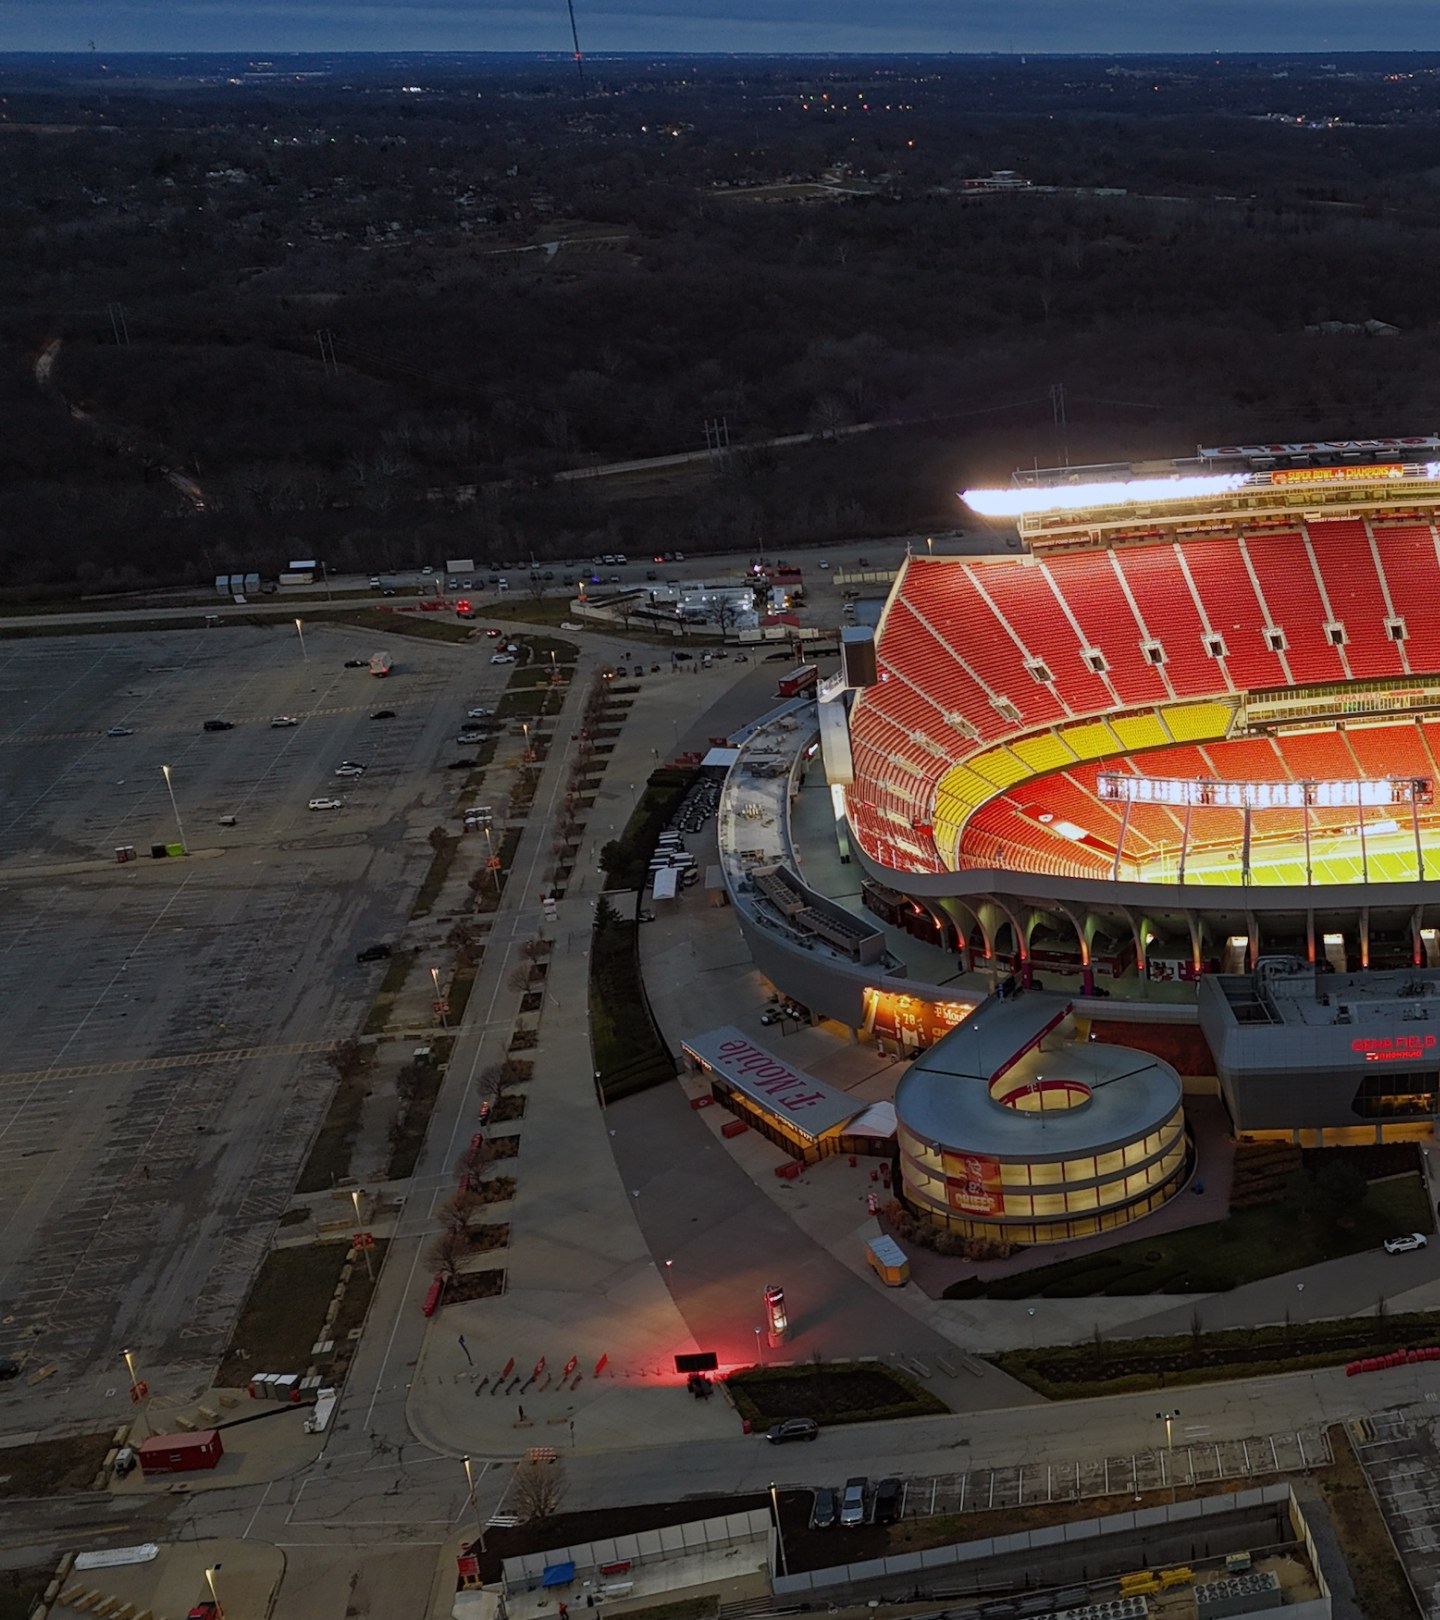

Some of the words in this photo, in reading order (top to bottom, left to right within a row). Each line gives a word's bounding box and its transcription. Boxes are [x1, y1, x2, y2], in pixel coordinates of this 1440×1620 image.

[1288, 471, 1311, 480] SUPER
[1313, 470, 1333, 479] BOWL
[1346, 467, 1388, 477] CHAMPIONS
[1358, 692, 1380, 701] FIELD
[903, 1013, 915, 1025] 78
[1351, 1038, 1392, 1051] GEHA
[1396, 1035, 1437, 1048] FIELD
[955, 1193, 995, 1208] CHIEFS
